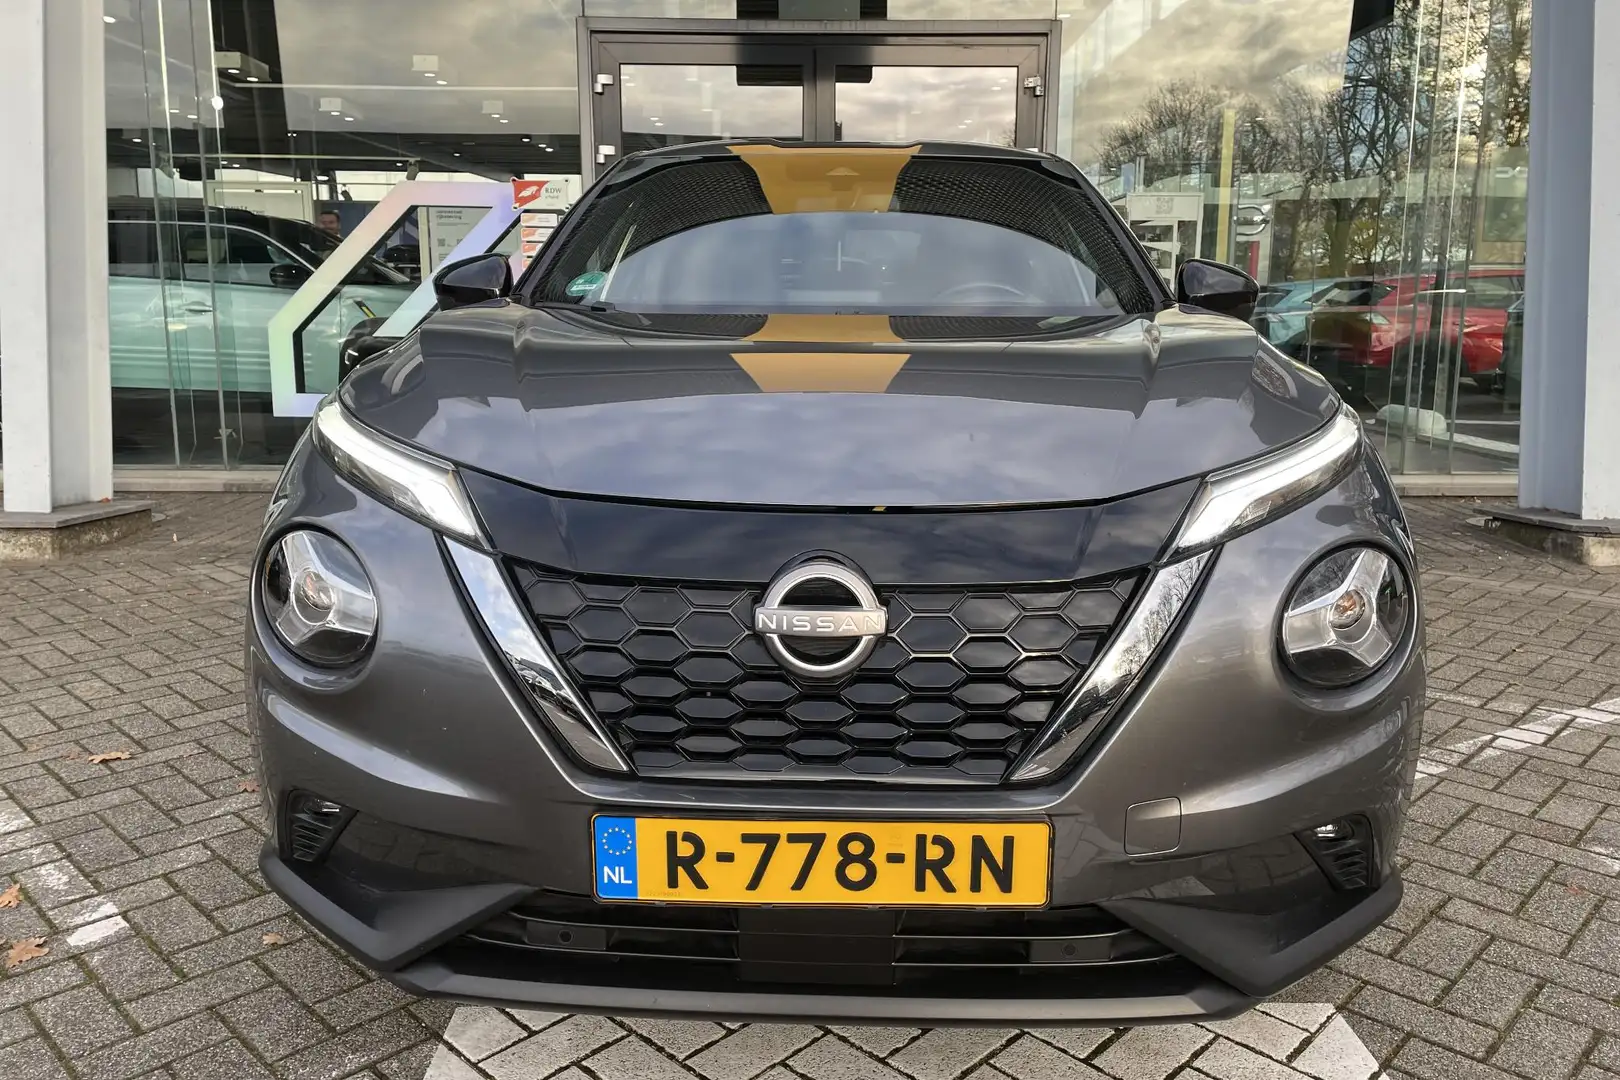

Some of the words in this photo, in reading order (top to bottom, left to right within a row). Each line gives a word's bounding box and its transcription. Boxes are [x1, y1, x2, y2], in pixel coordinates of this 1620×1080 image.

[758, 613, 881, 632] NISSAN
[665, 830, 1015, 893] R-778-RN
[603, 865, 632, 884] NL
